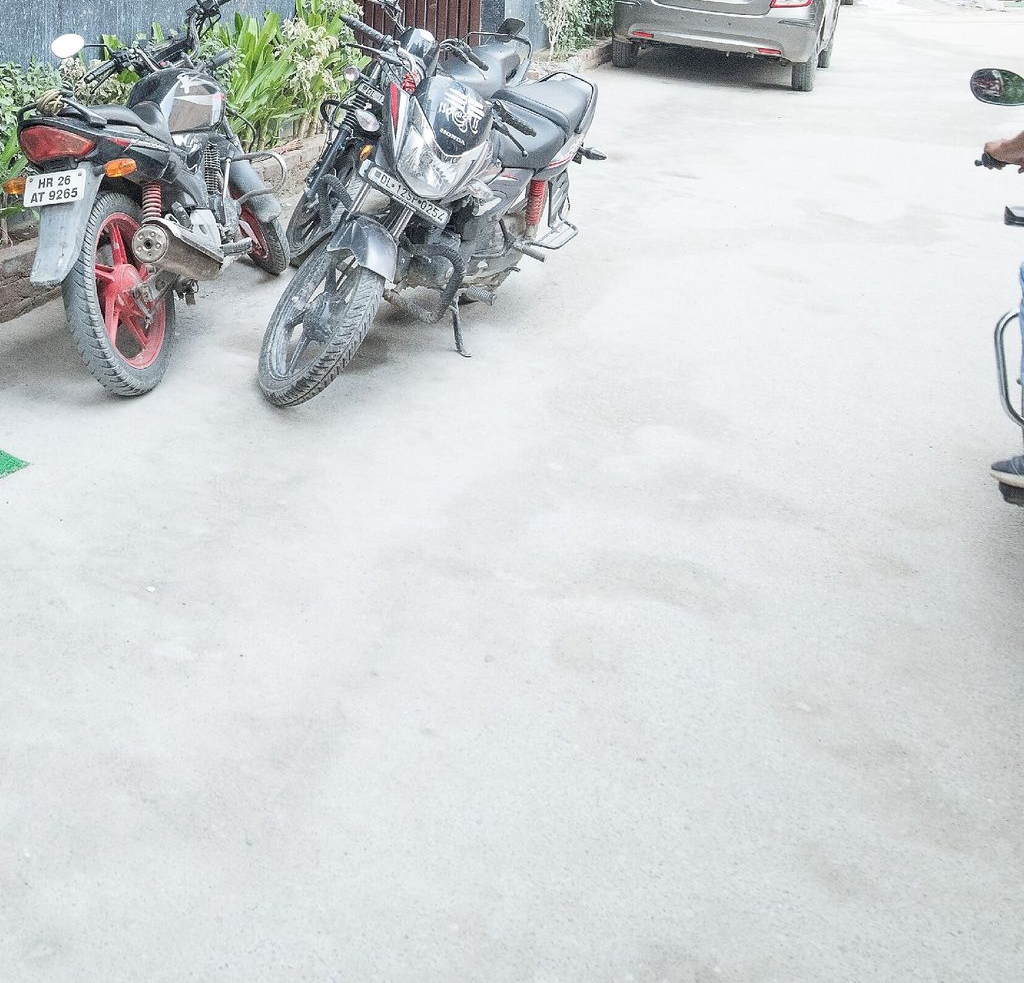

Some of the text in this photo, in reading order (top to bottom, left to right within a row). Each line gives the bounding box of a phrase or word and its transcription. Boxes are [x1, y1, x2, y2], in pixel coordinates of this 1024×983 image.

[439, 127, 465, 145] HONDA
[38, 175, 71, 189] HR 26
[30, 188, 78, 203] AT 9265
